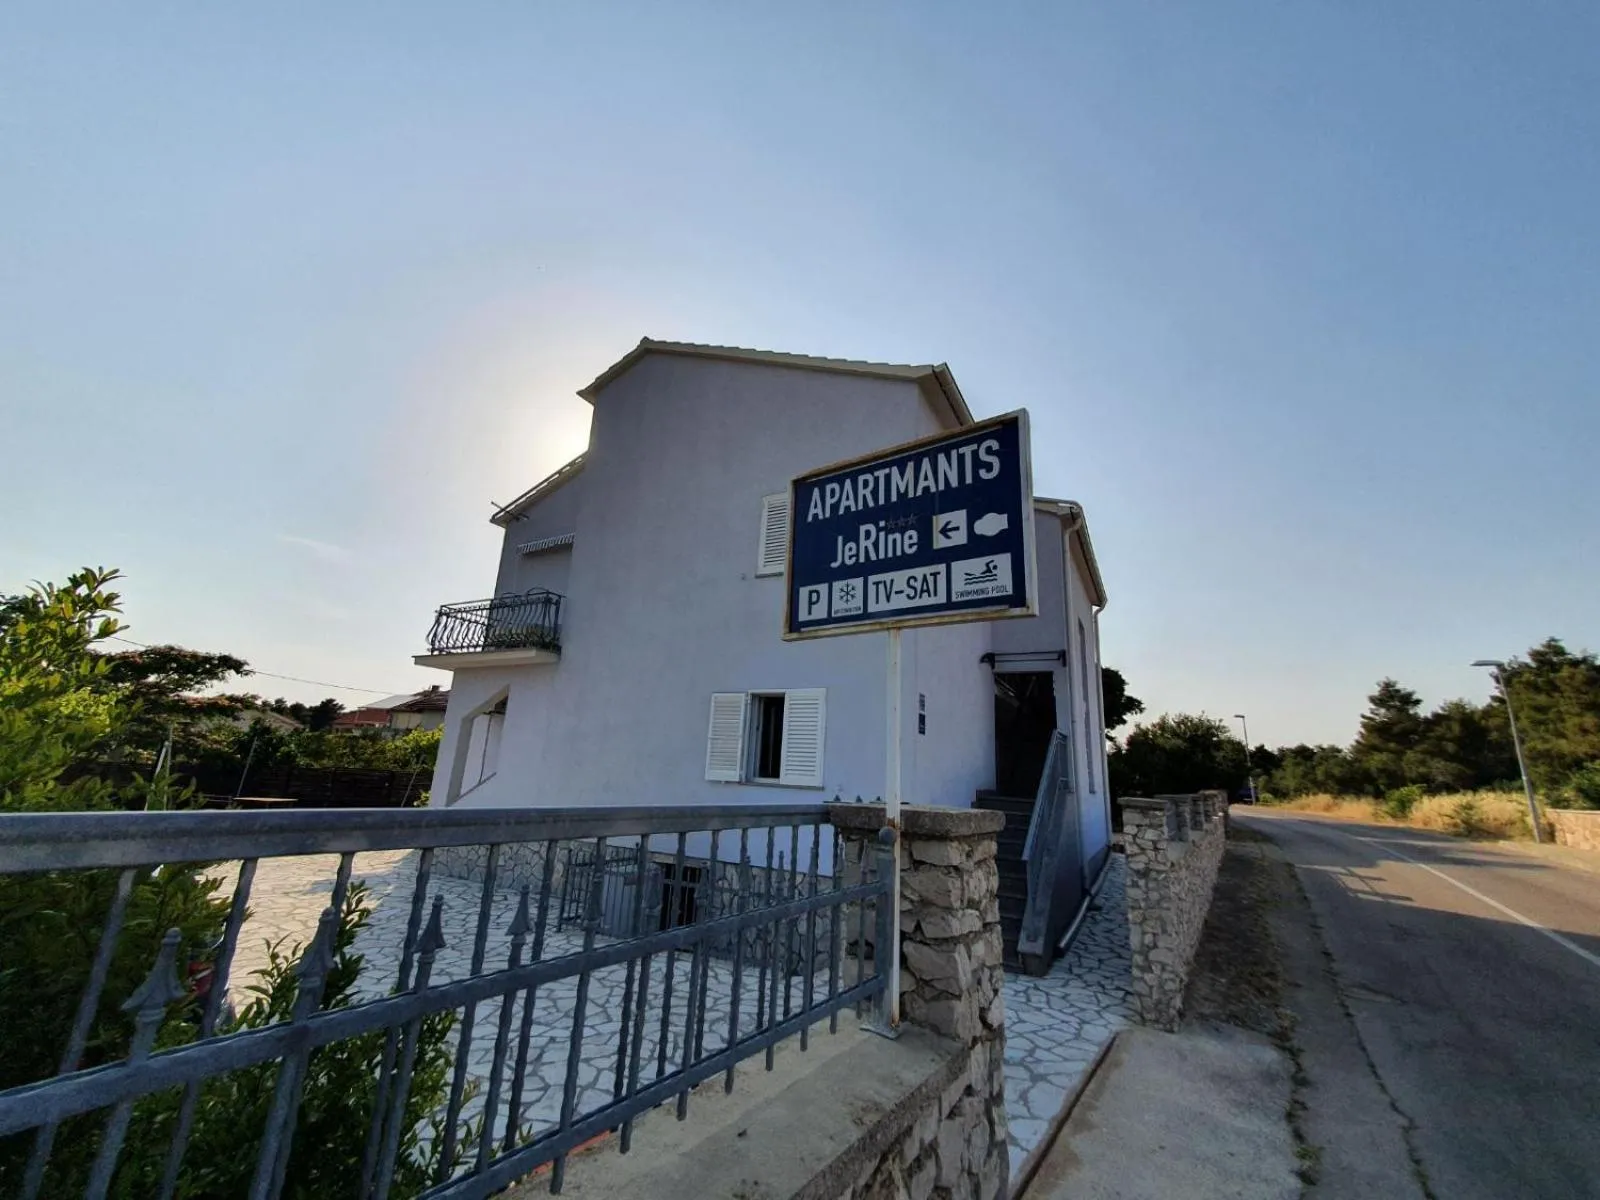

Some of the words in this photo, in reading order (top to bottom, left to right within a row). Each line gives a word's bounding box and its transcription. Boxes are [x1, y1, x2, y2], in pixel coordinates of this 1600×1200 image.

[807, 439, 1001, 522] APARTMANTS
[830, 520, 918, 568] JeRine
[807, 589, 820, 616] P
[872, 571, 941, 605] TV-SAT
[955, 587, 989, 599] SWIMMING
[991, 584, 1009, 595] POOL
